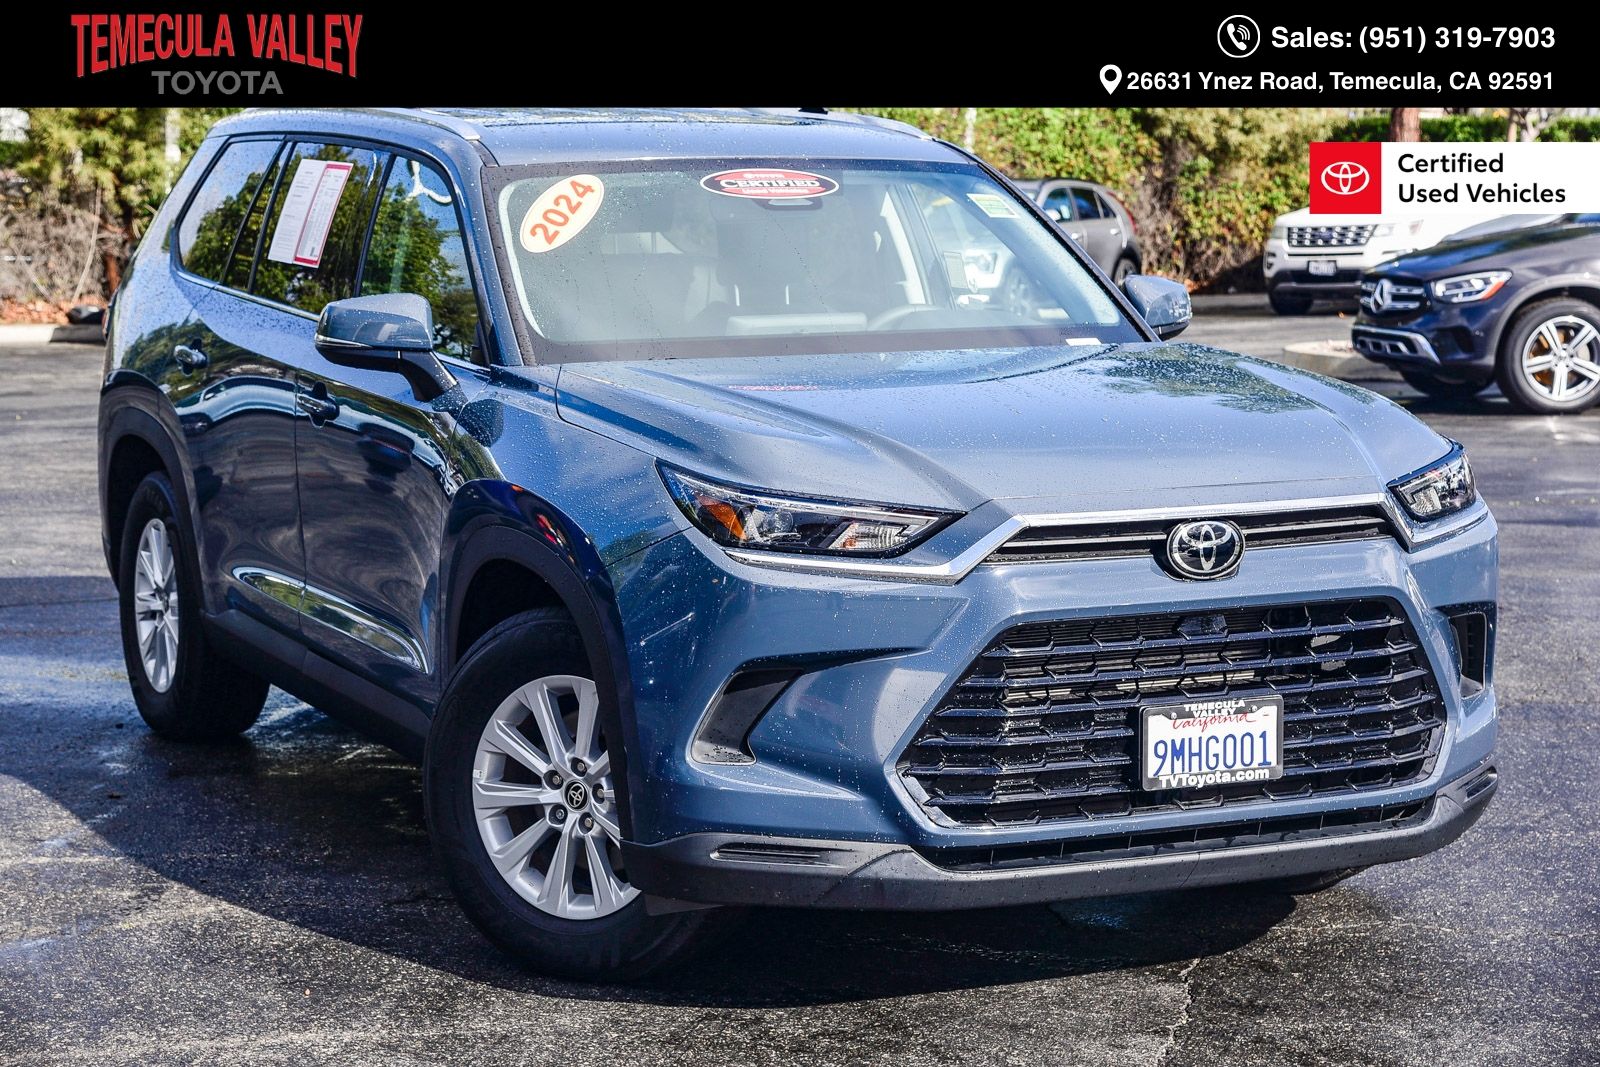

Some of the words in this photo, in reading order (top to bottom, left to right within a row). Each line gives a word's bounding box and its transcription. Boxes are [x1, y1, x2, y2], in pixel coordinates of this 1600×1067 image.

[530, 180, 595, 245] 2024
[1184, 700, 1245, 712] TEMECULA
[1193, 708, 1236, 718] VALLEY
[1172, 712, 1257, 732] California
[1153, 731, 1272, 777] 9MHG001
[1159, 768, 1270, 788] TVToyota.com
